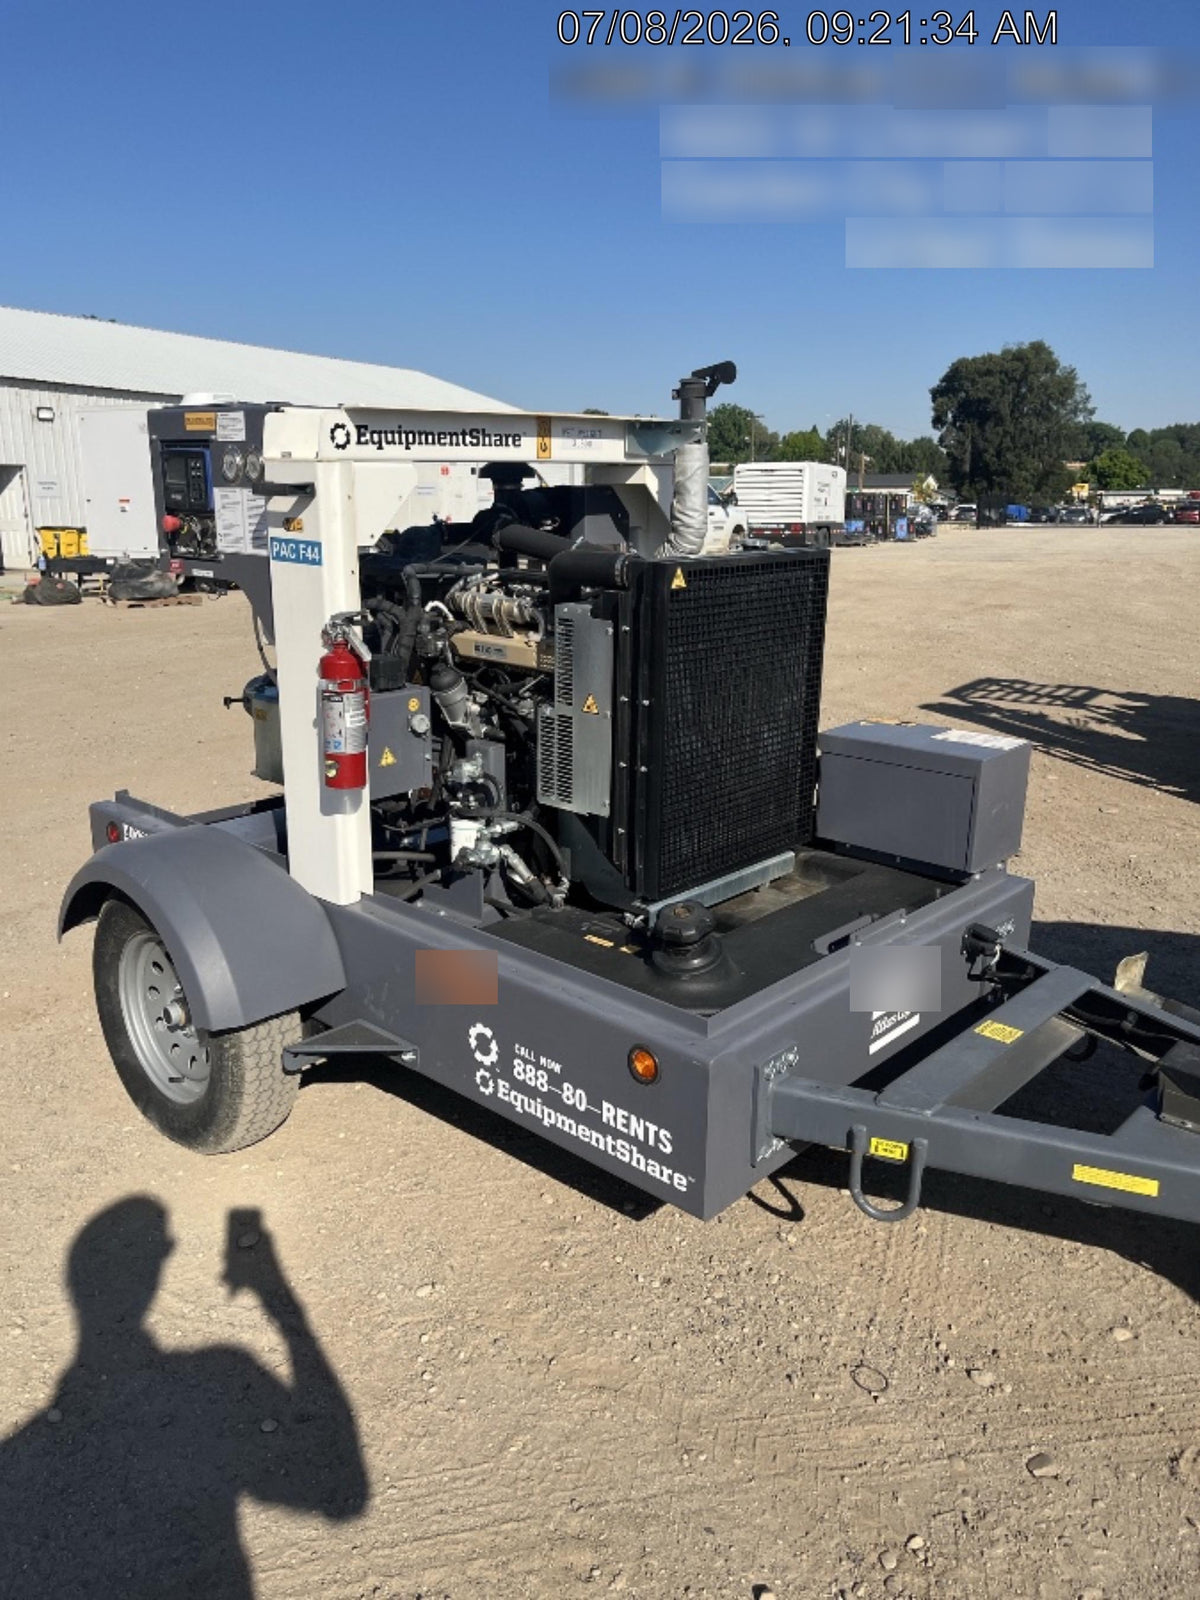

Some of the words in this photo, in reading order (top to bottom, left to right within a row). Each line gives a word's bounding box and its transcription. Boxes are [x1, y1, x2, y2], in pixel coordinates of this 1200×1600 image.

[355, 424, 522, 450] EquipmentShare
[272, 541, 297, 559] PAC
[298, 543, 321, 564] F44
[514, 1043, 536, 1062] CALL
[513, 1058, 673, 1155] 888-80-RENTS
[497, 1079, 688, 1192] EquipmentShare
